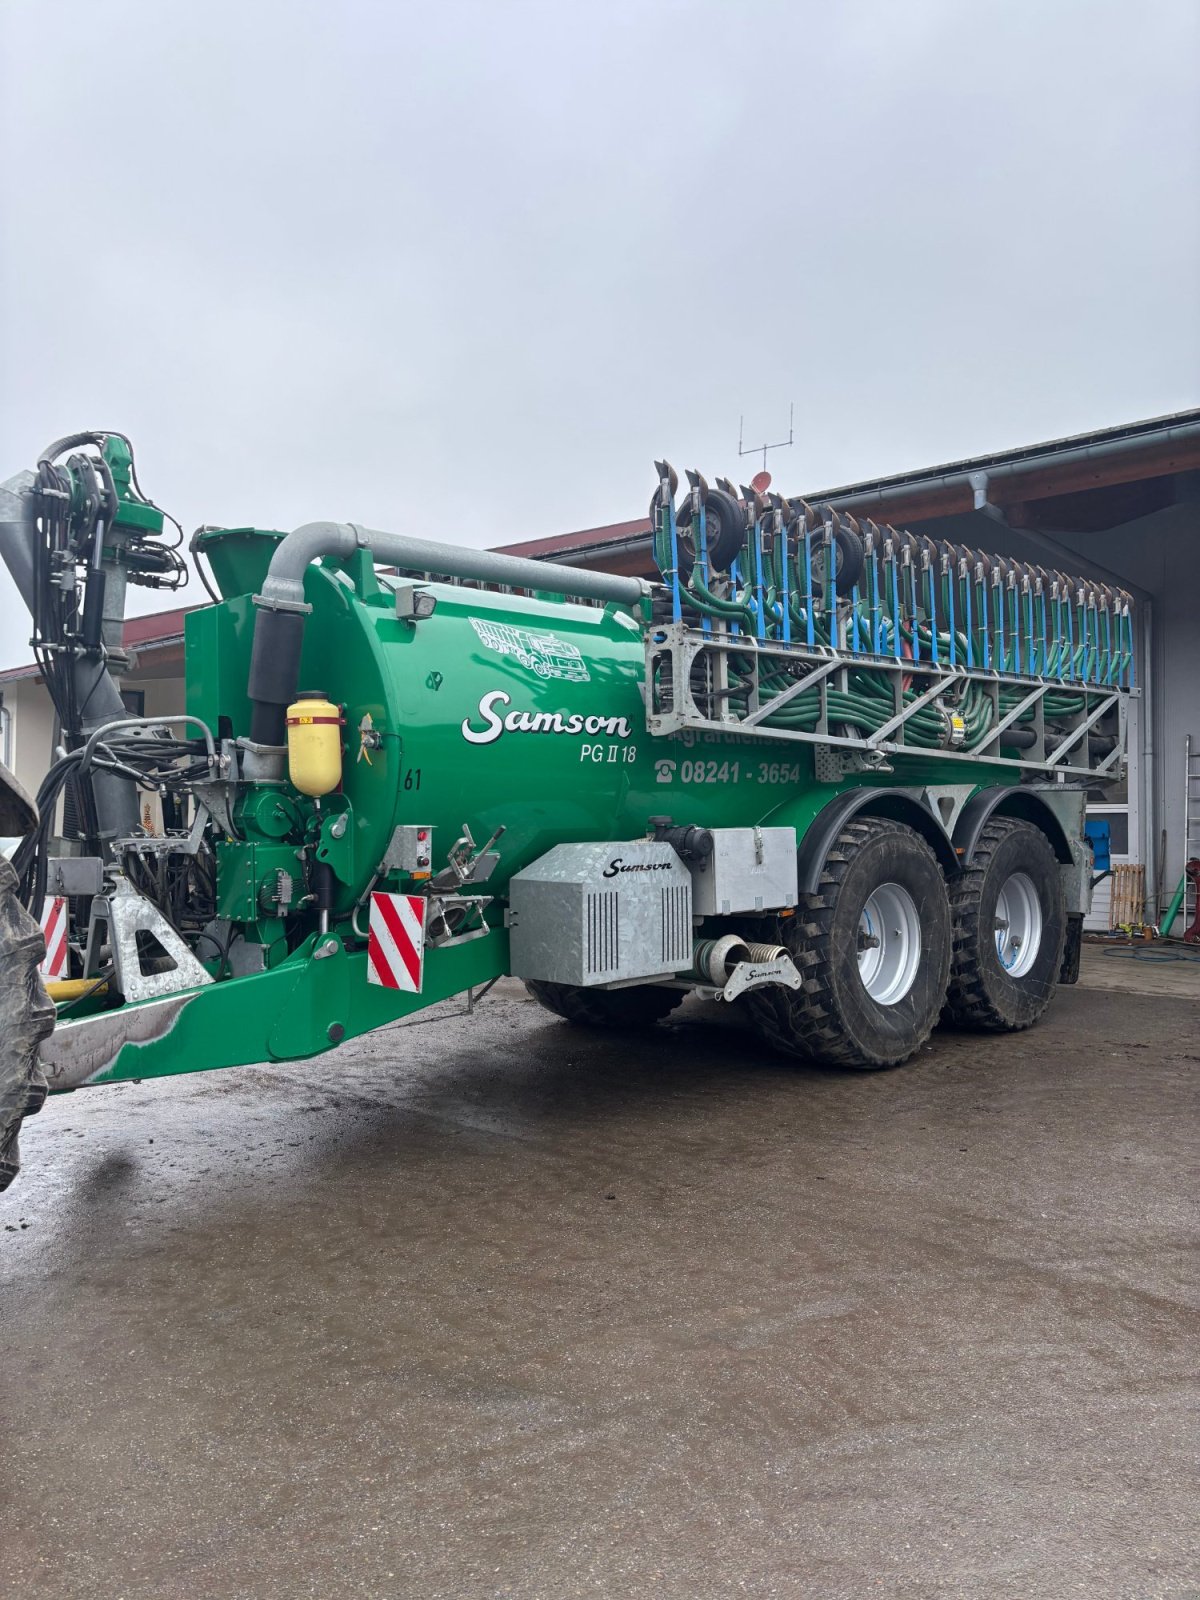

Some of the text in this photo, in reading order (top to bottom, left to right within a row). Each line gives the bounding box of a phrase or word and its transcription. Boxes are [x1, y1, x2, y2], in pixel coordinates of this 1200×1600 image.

[461, 690, 632, 744] Samson
[580, 744, 603, 763] PG
[622, 746, 637, 763] 18
[404, 768, 421, 790] 61
[680, 760, 740, 783] 08241
[757, 762, 800, 784] 3654
[603, 858, 673, 878] Samson
[745, 969, 782, 981] Samson
